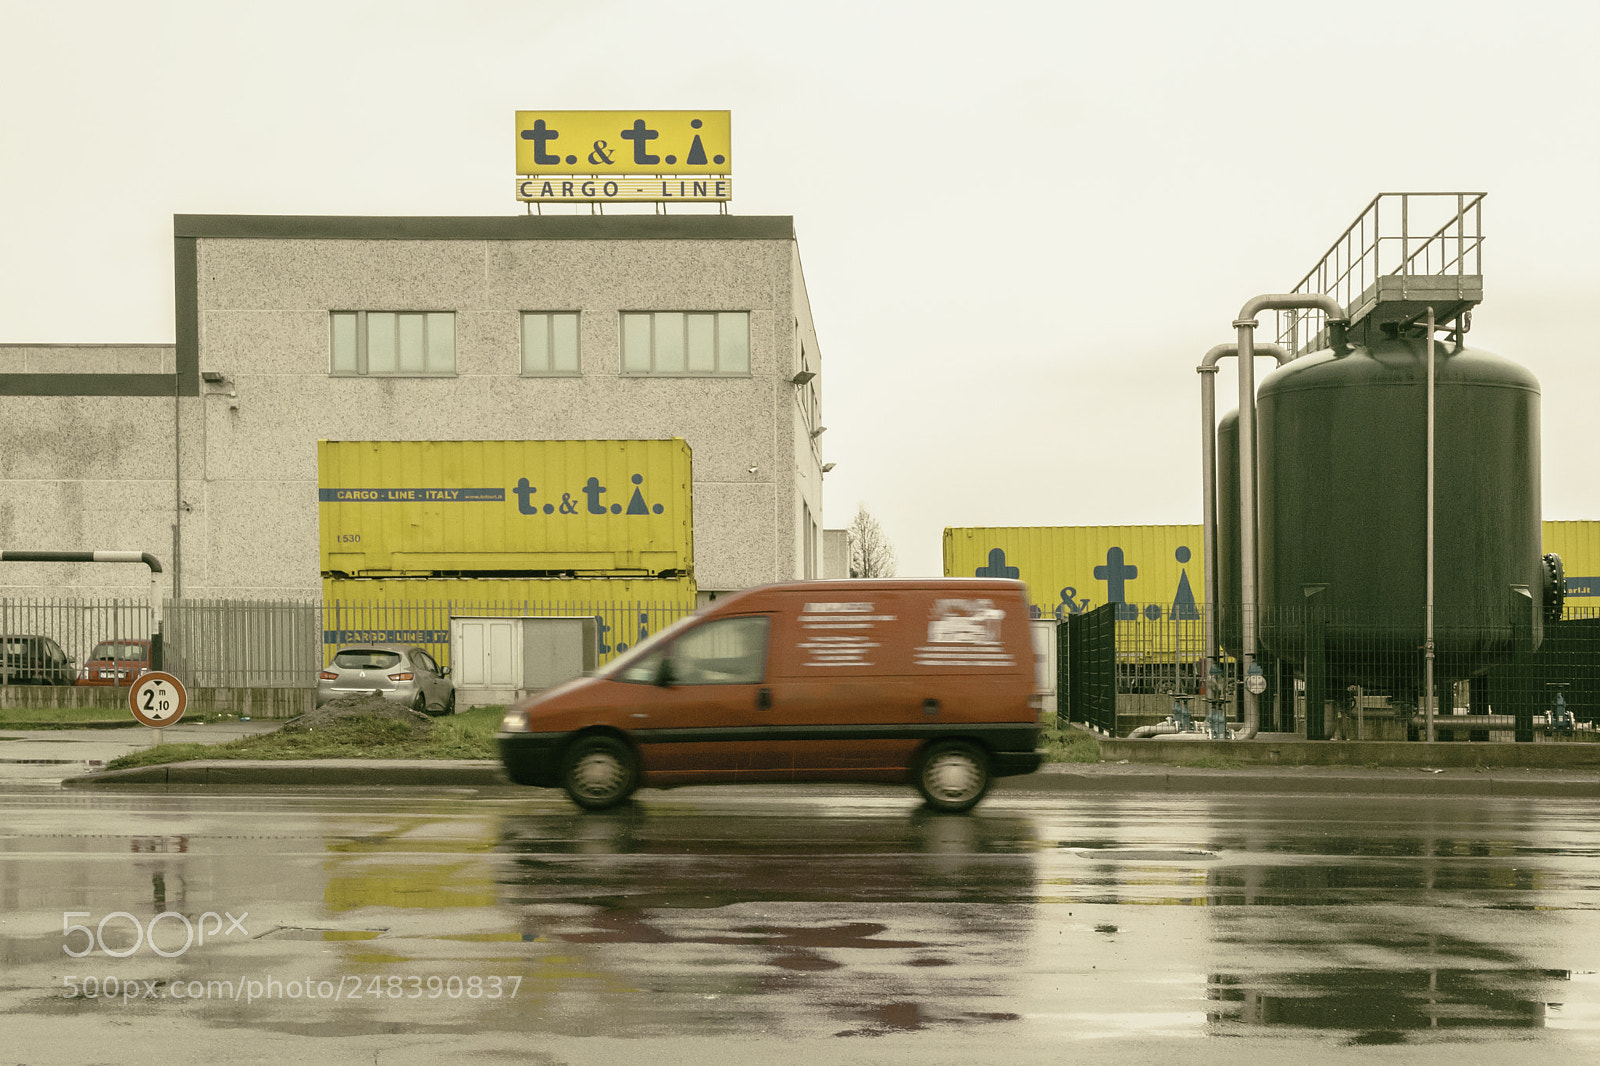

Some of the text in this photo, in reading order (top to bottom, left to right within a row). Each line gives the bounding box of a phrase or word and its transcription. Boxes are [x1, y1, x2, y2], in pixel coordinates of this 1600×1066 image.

[520, 181, 619, 197] CARGO
[662, 181, 727, 197] LINE
[337, 490, 379, 500] CARGO
[388, 490, 416, 500] LINE
[425, 490, 460, 500] ITALY
[345, 632, 387, 641] CARGO
[396, 632, 424, 641] LINE
